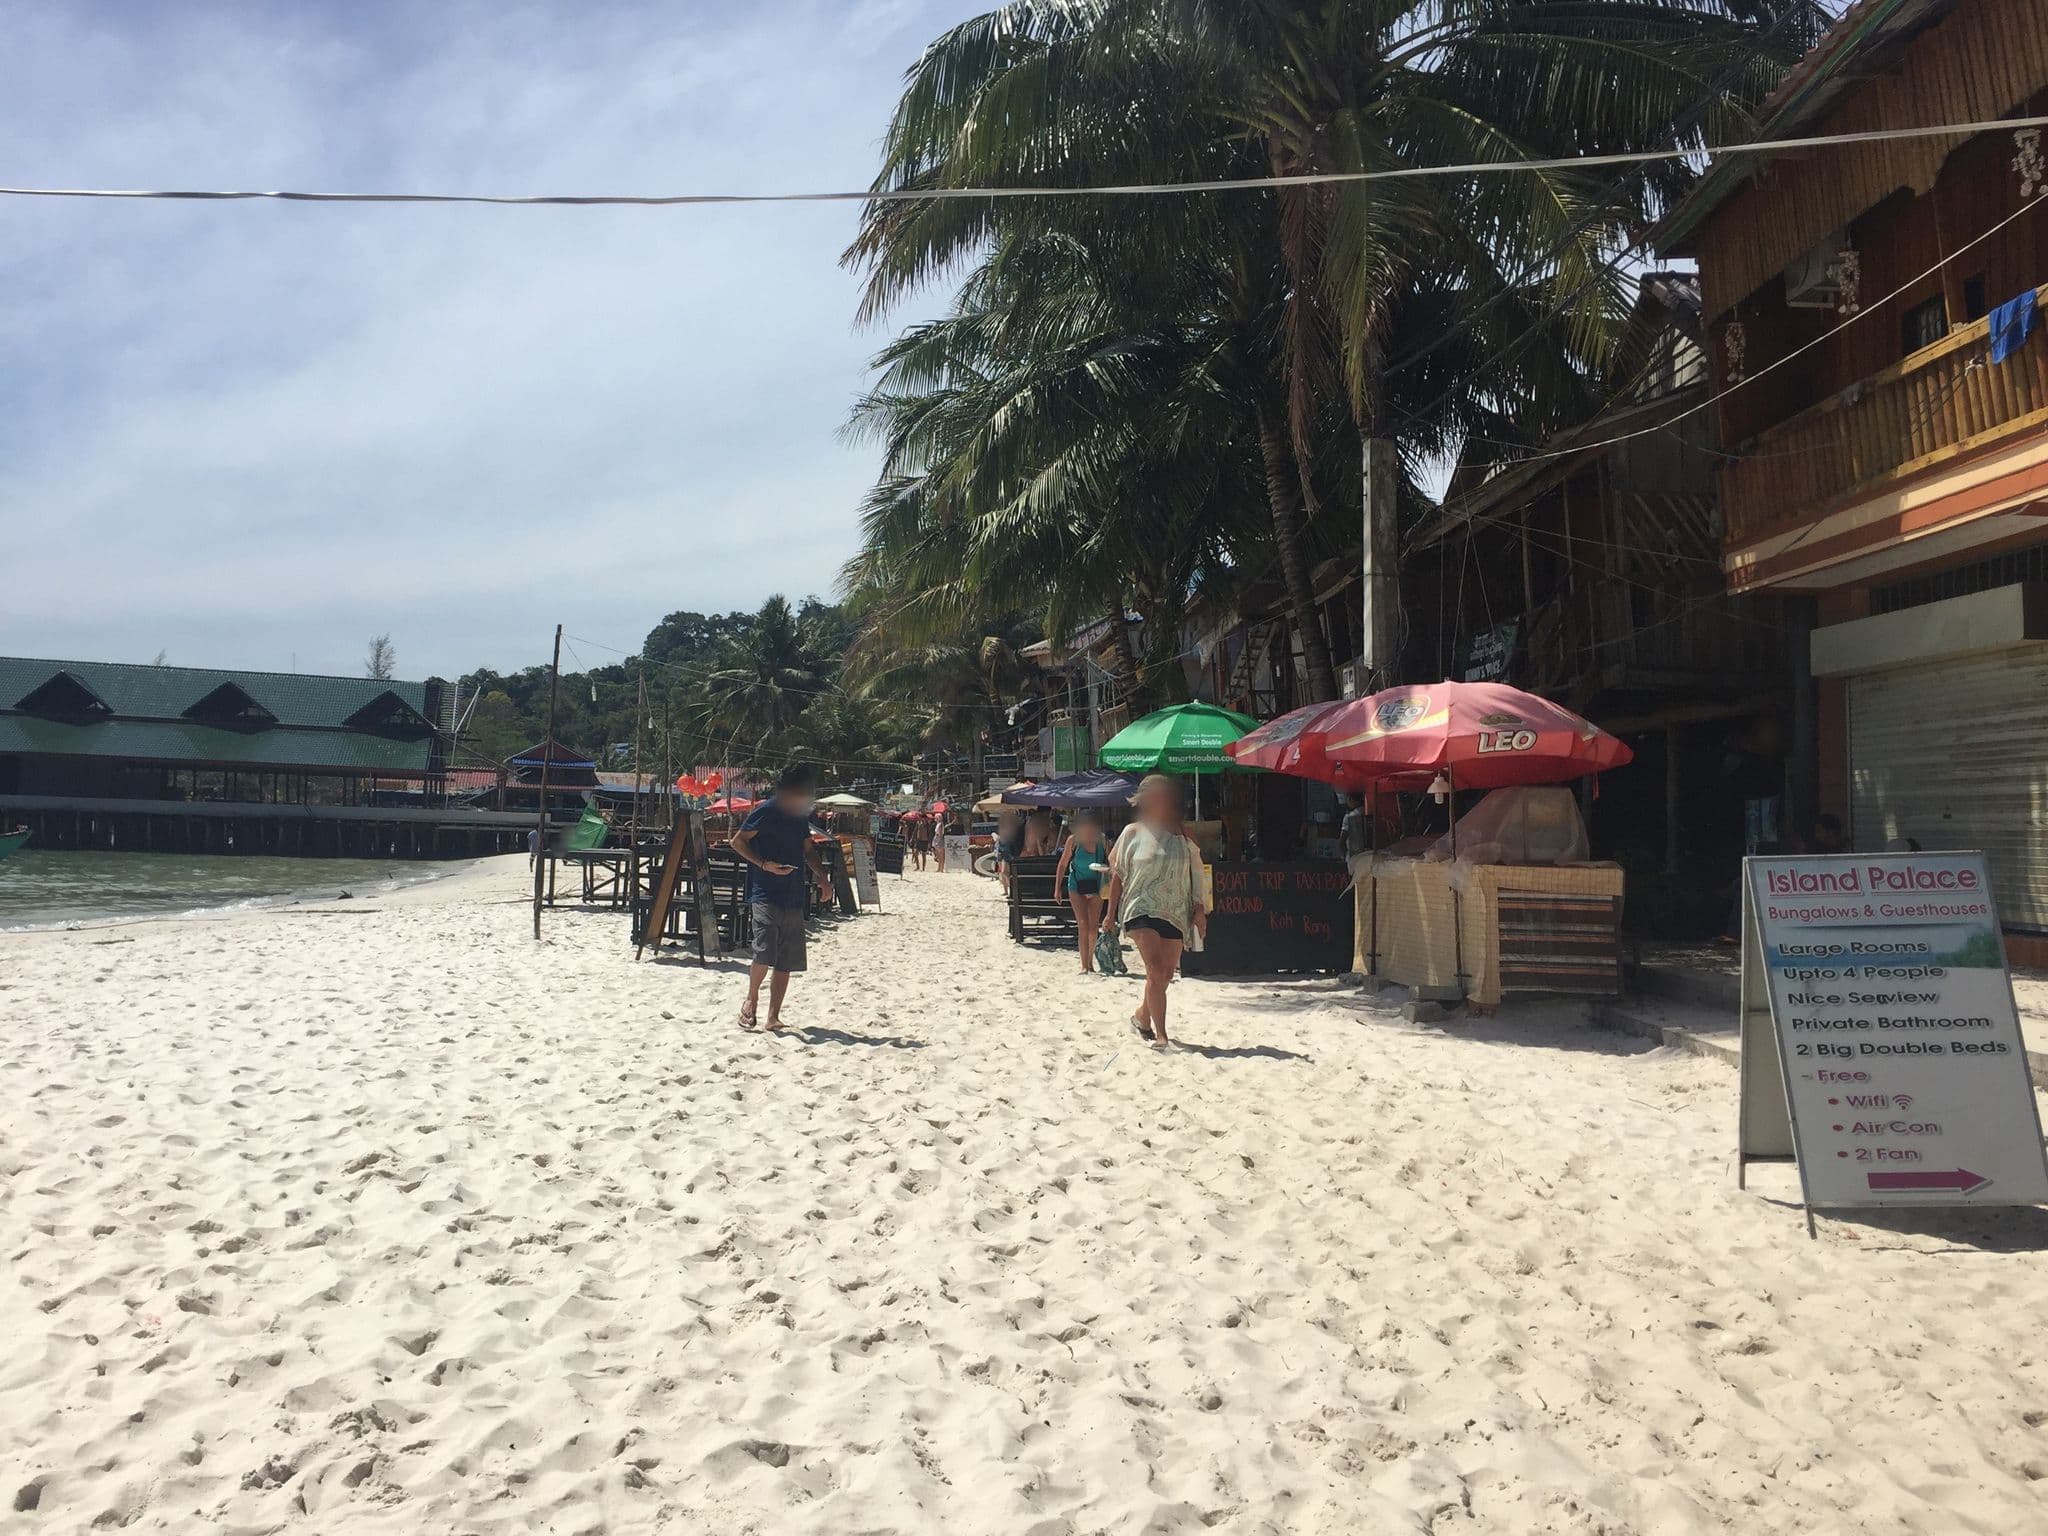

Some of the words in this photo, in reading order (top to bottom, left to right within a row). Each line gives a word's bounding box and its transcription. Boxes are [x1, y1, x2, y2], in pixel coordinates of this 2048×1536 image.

[1201, 738, 1222, 746] Double
[1477, 730, 1538, 754] LEO
[1215, 871, 1249, 892] BOAT
[1258, 871, 1286, 891] TRIP
[1767, 867, 1861, 894] Island
[1869, 865, 1980, 892] Palace
[1216, 896, 1264, 913] AROUND
[1768, 906, 1859, 923] Bungalows
[1864, 904, 1875, 917] &
[1880, 902, 1987, 918] Guesthouses
[1779, 943, 1844, 957] Large
[1850, 941, 1928, 954] Rooms
[1783, 966, 1836, 982] Upto
[1843, 966, 1857, 979] 4
[1864, 965, 1944, 981] People
[1788, 992, 1841, 1005] Nice
[1792, 1018, 1870, 1030] Private
[1879, 1016, 1990, 1029] Bathroom
[1796, 1044, 1810, 1056] 2
[1817, 1043, 1852, 1058] Big
[1860, 1042, 1943, 1055] Double
[1951, 1041, 2007, 1055] Beds
[1817, 1069, 1869, 1082] Free
[1846, 1095, 1887, 1107] Wifi
[1851, 1121, 1882, 1134] Air
[1889, 1120, 1939, 1133] Con
[1855, 1148, 1869, 1161] 2
[1876, 1147, 1919, 1161] Fan
